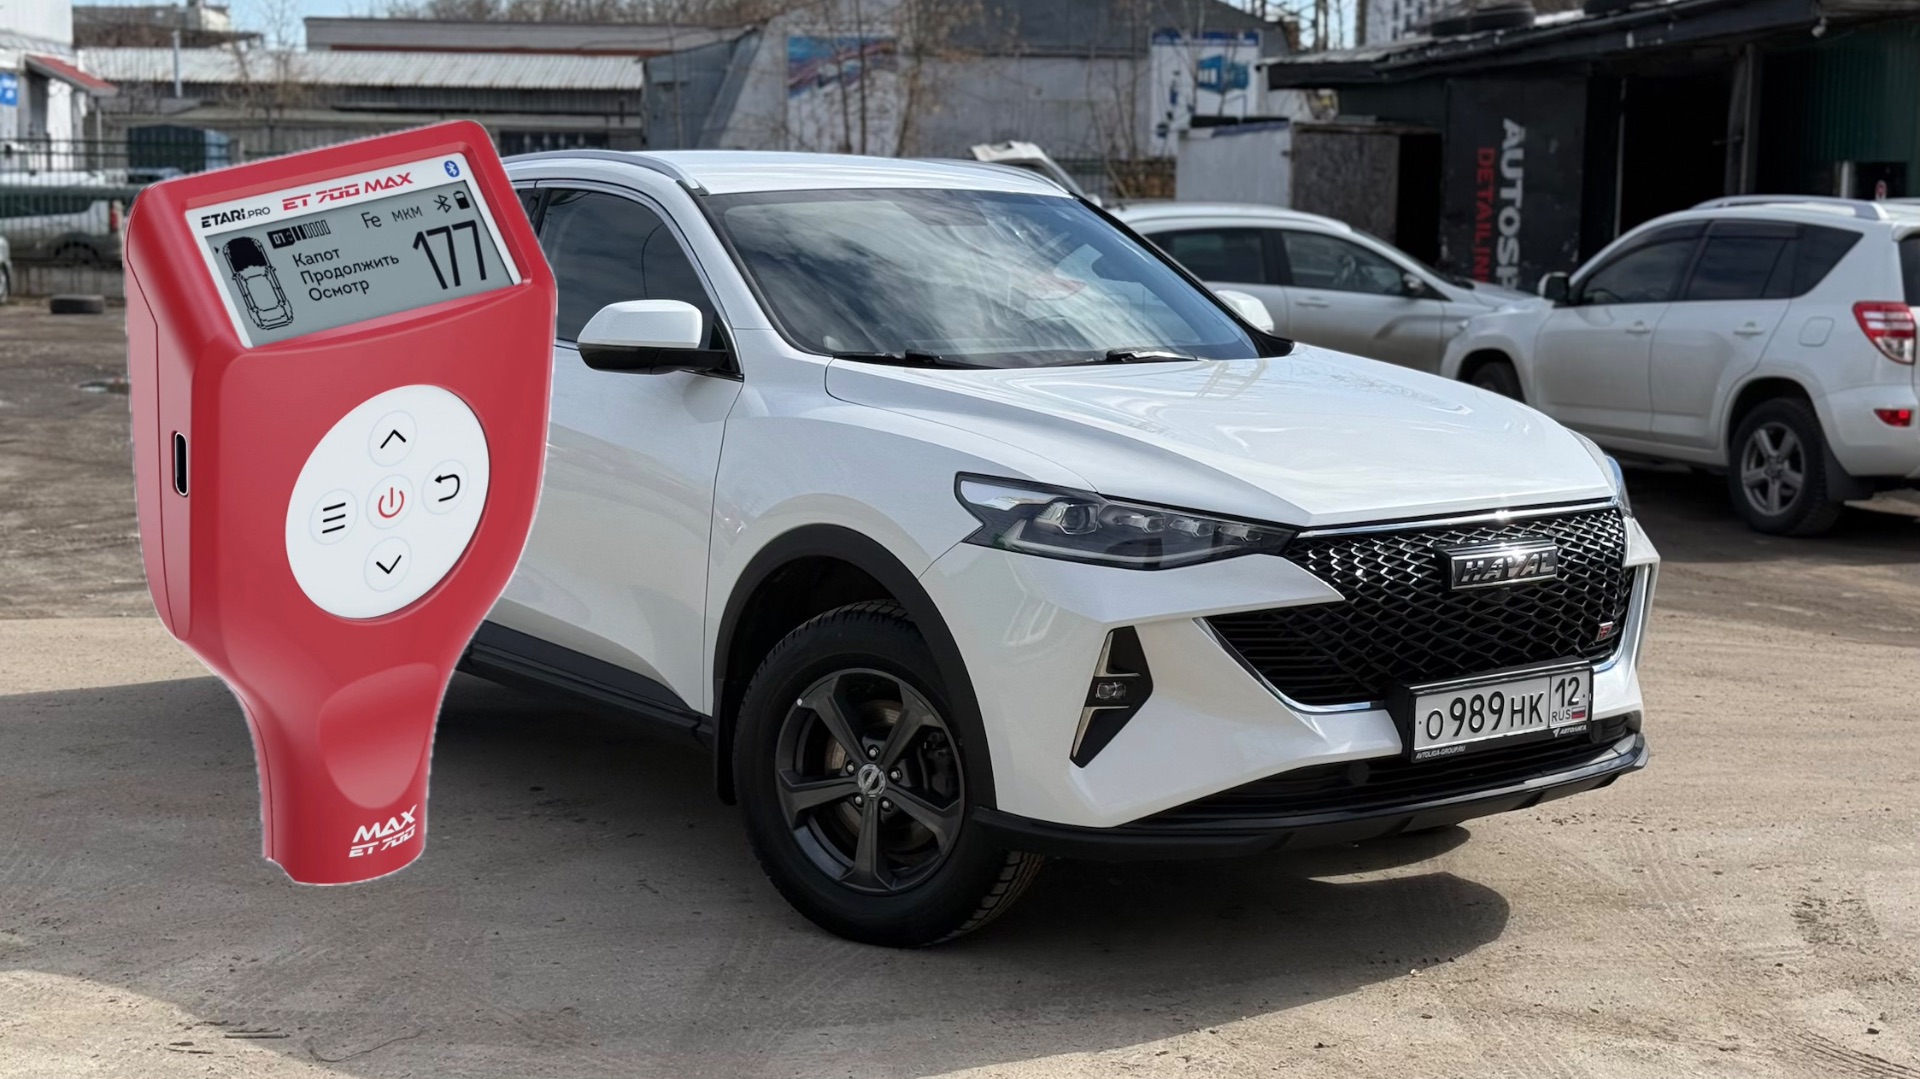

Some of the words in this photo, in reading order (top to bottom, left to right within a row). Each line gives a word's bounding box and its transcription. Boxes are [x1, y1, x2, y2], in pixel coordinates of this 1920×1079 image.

[282, 194, 311, 211] ET
[315, 183, 360, 204] 700
[364, 172, 414, 194] MAX
[361, 211, 382, 229] Fe
[292, 248, 340, 267] Капот
[412, 219, 487, 290] 177
[300, 255, 400, 286] Продолжить
[308, 279, 370, 301] Осмотр
[1461, 552, 1556, 583] HAVAL
[1554, 676, 1580, 708] 12
[1552, 710, 1571, 722] RUS
[352, 804, 418, 843] MAX
[348, 841, 379, 858] ET
[380, 824, 416, 851] 700
